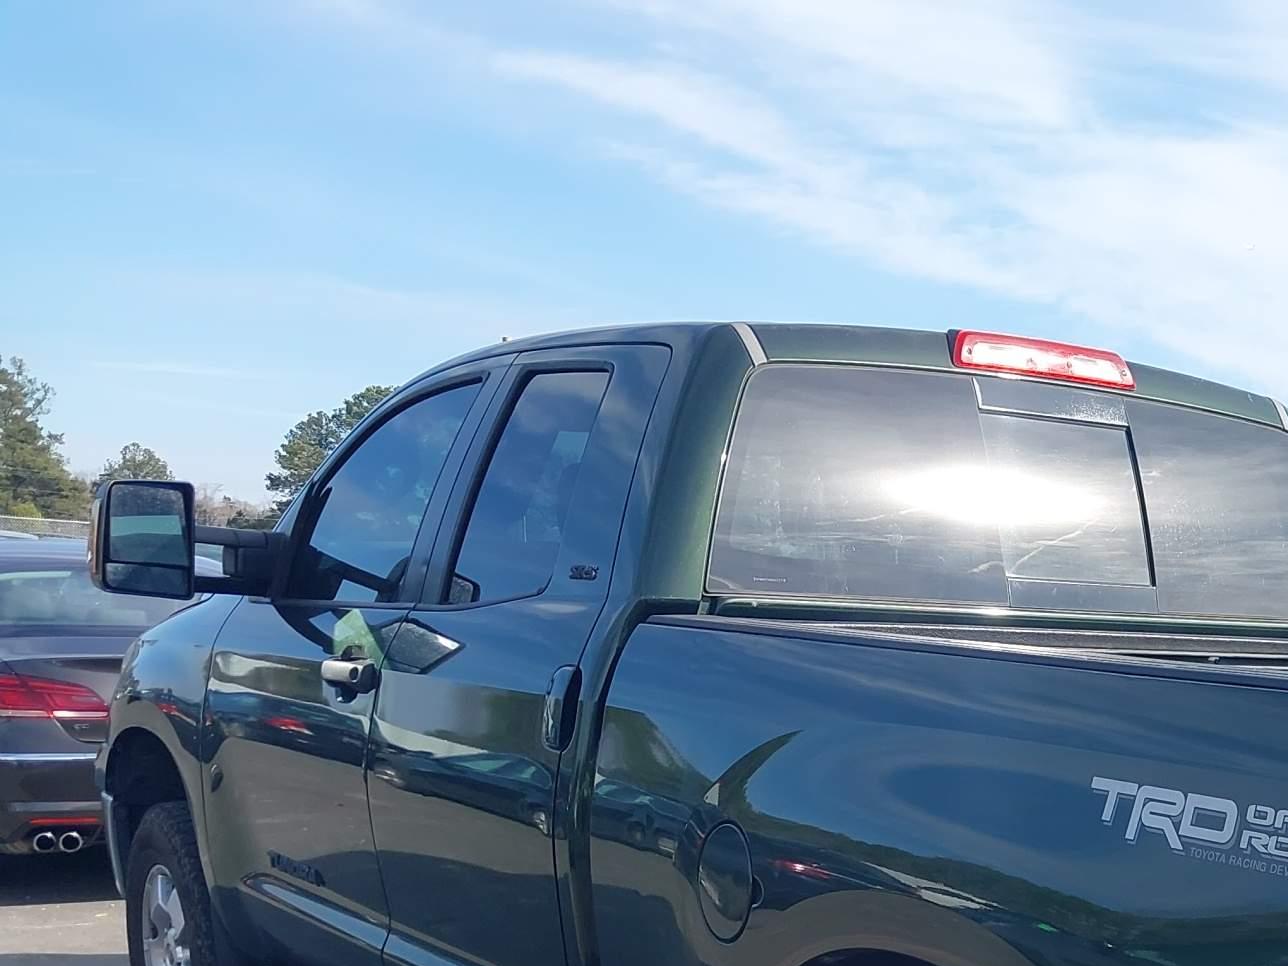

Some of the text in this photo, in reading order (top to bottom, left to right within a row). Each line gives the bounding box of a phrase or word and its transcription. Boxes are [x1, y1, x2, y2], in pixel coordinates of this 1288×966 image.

[1091, 776, 1240, 852] TRD
[1190, 847, 1227, 865] TOYOTA
[1228, 855, 1267, 873] RACING
